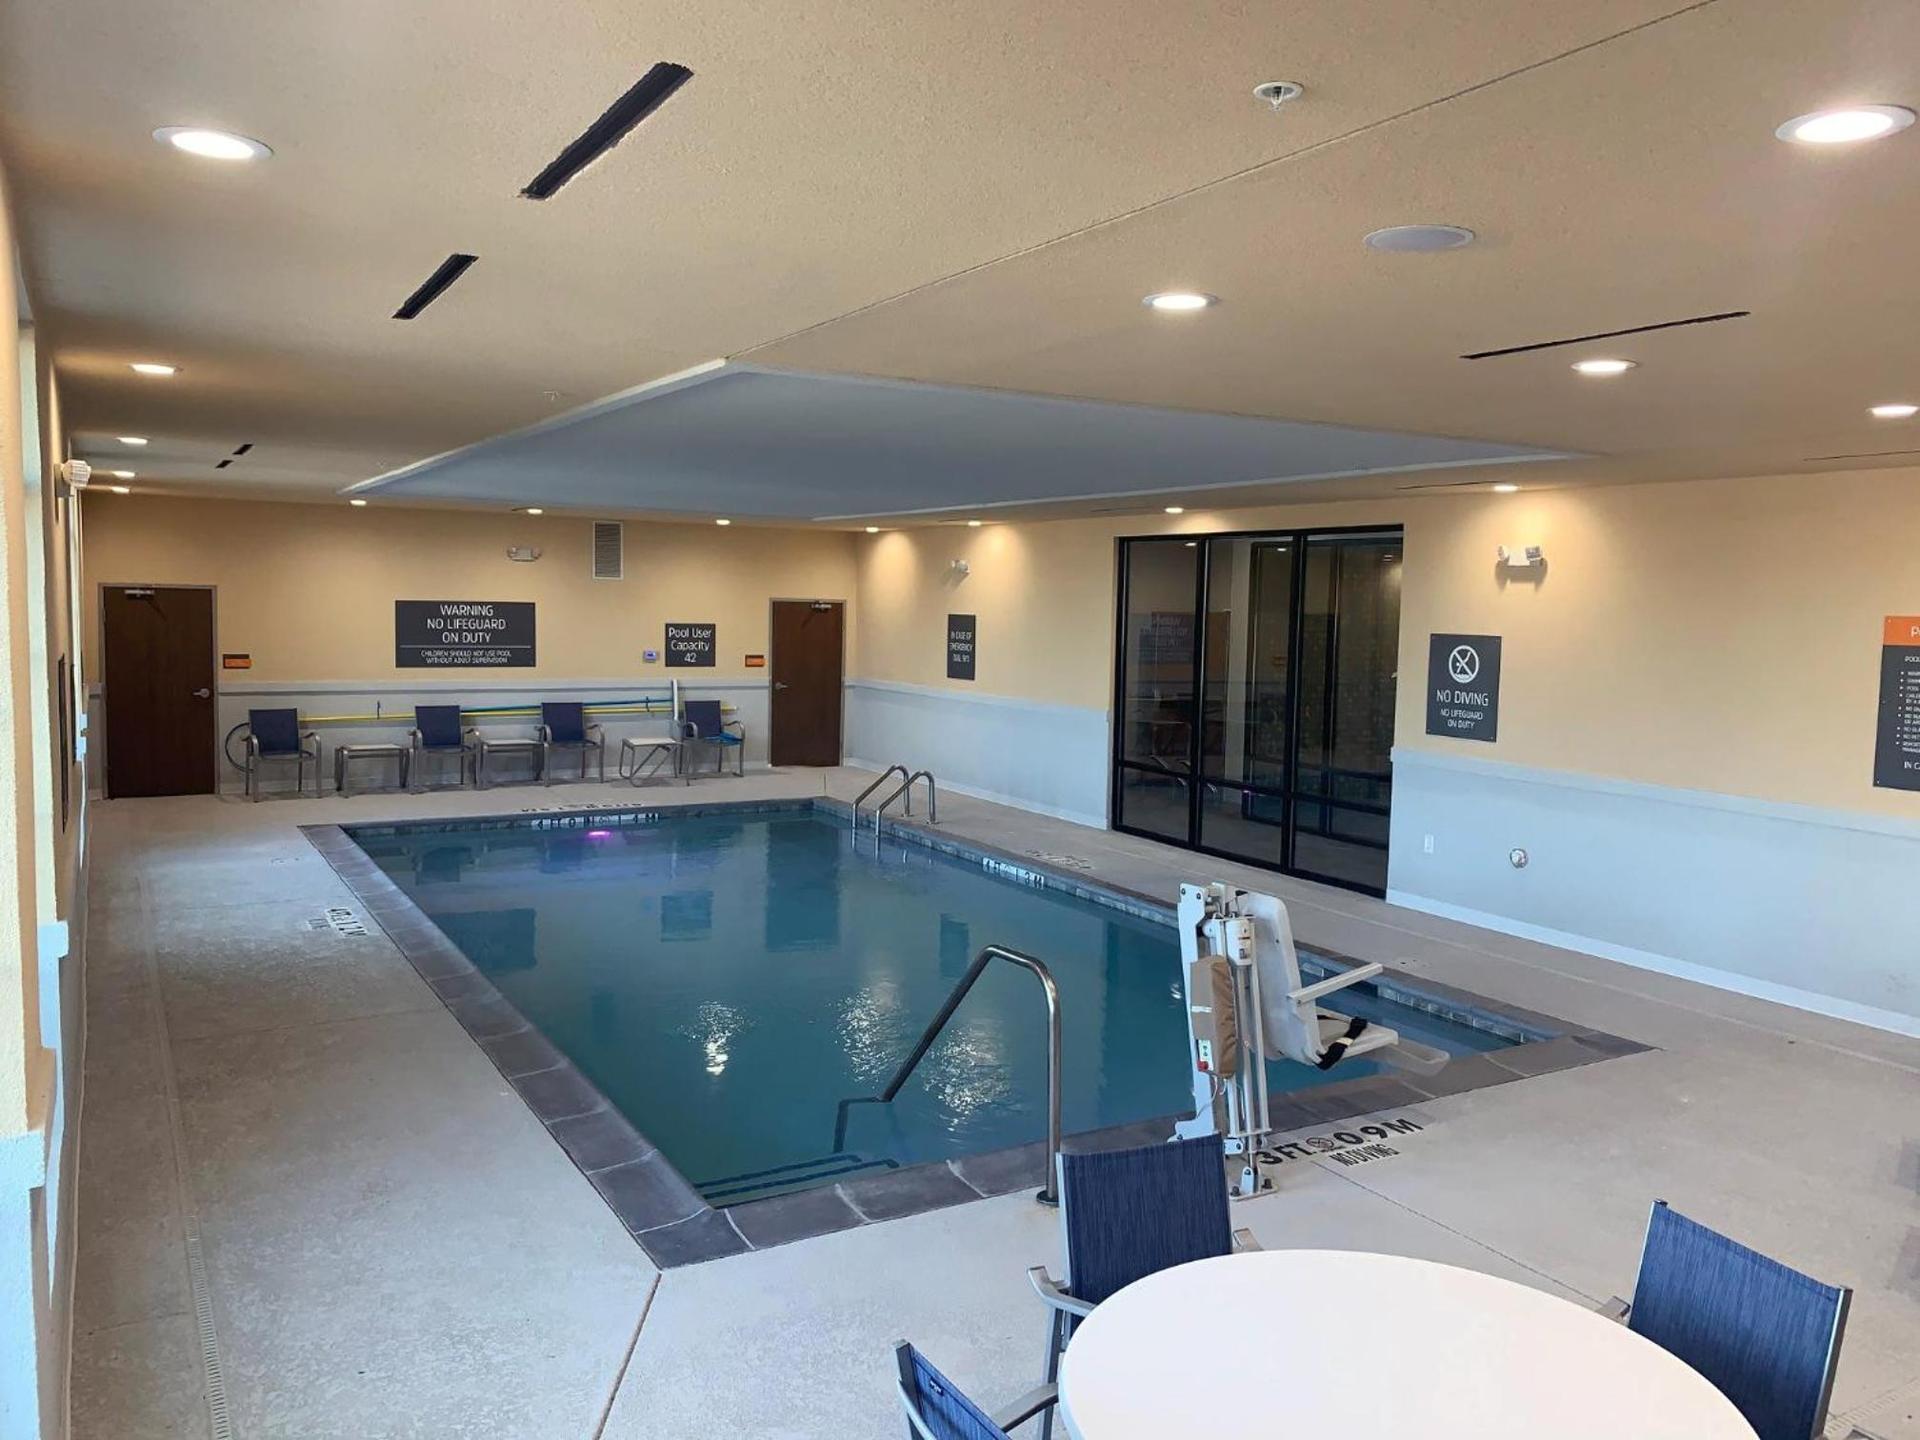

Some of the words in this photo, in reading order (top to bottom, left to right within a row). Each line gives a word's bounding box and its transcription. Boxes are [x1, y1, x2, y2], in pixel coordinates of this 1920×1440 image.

[440, 605, 494, 617] WARNING
[427, 618, 444, 630] NO
[447, 618, 506, 630] LIFEGUARD
[442, 631, 459, 643] ON
[462, 632, 492, 644] DUTY
[668, 627, 690, 638] Pool
[692, 627, 712, 638] User
[671, 640, 710, 651] Capacity
[684, 652, 697, 663] 42
[1436, 689, 1451, 703] NO
[1454, 690, 1489, 706] DIVING
[1440, 708, 1449, 717] NO
[1451, 709, 1483, 720] LIFEGUARD
[1447, 719, 1457, 727] ON
[1458, 720, 1475, 729] DUTY
